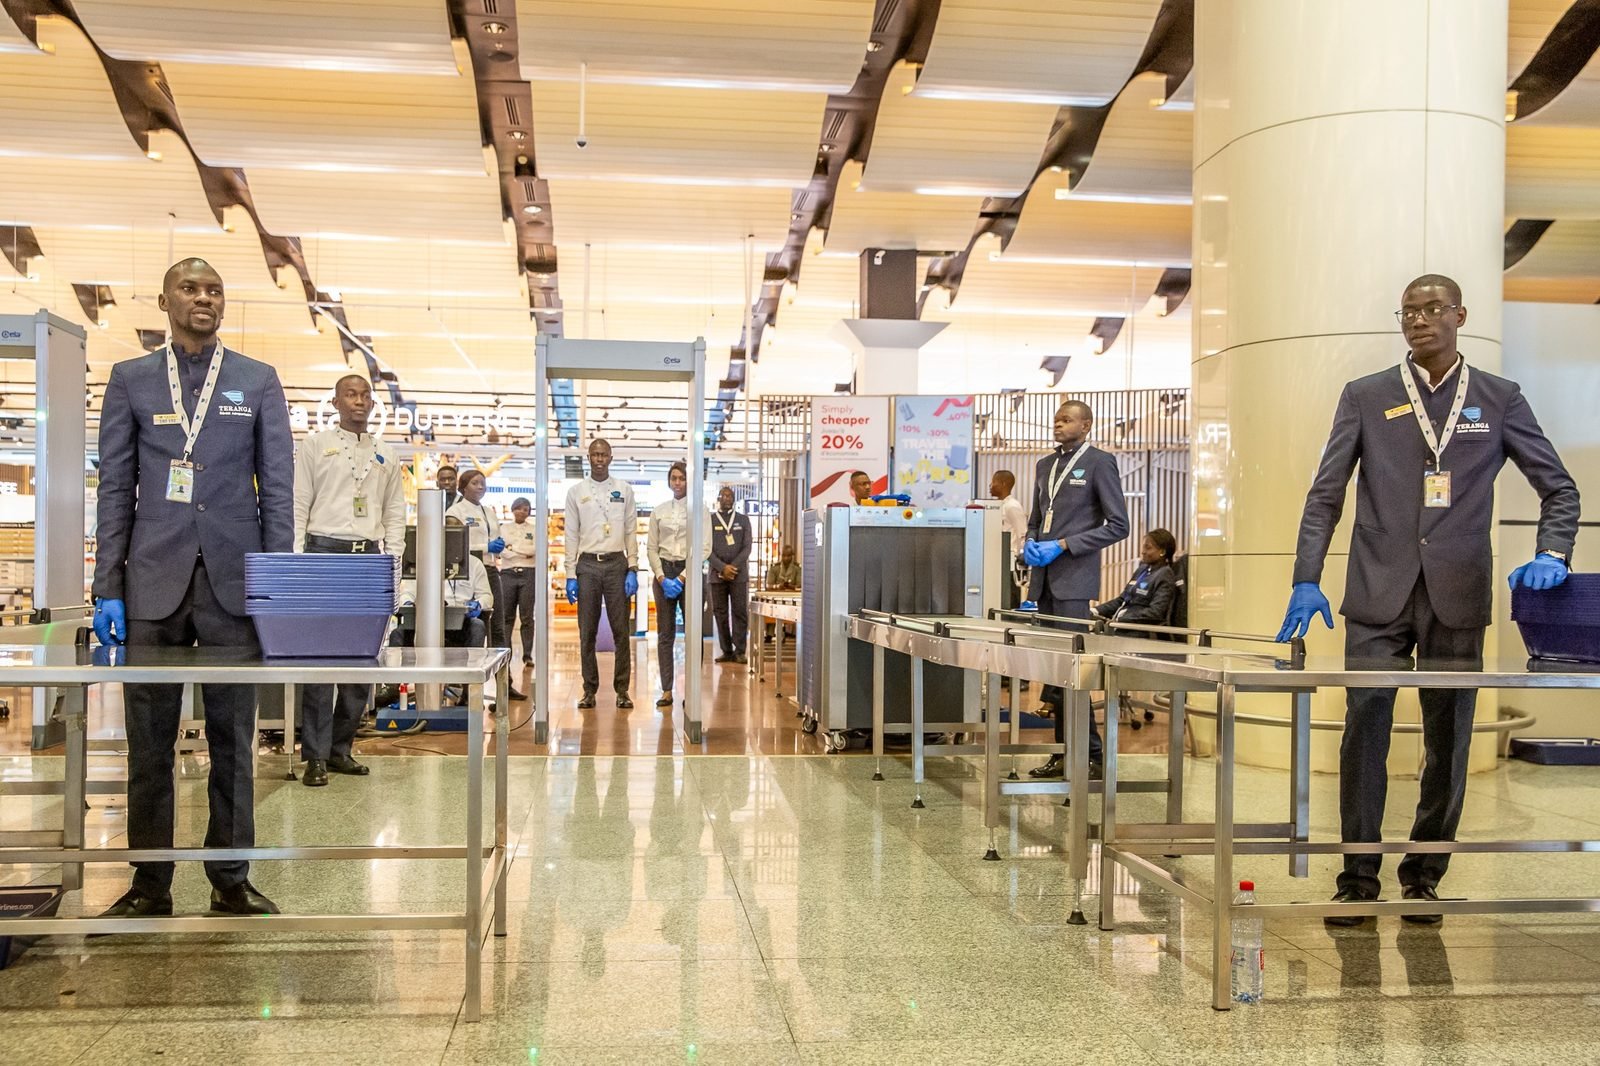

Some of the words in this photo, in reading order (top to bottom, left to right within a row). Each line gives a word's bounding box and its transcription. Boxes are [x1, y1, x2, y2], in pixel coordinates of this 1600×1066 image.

[218, 405, 252, 414] TERANGA
[821, 404, 854, 414] Simply
[821, 415, 870, 427] cheaper
[1455, 422, 1490, 430] TERANGA
[821, 434, 864, 449] 20%
